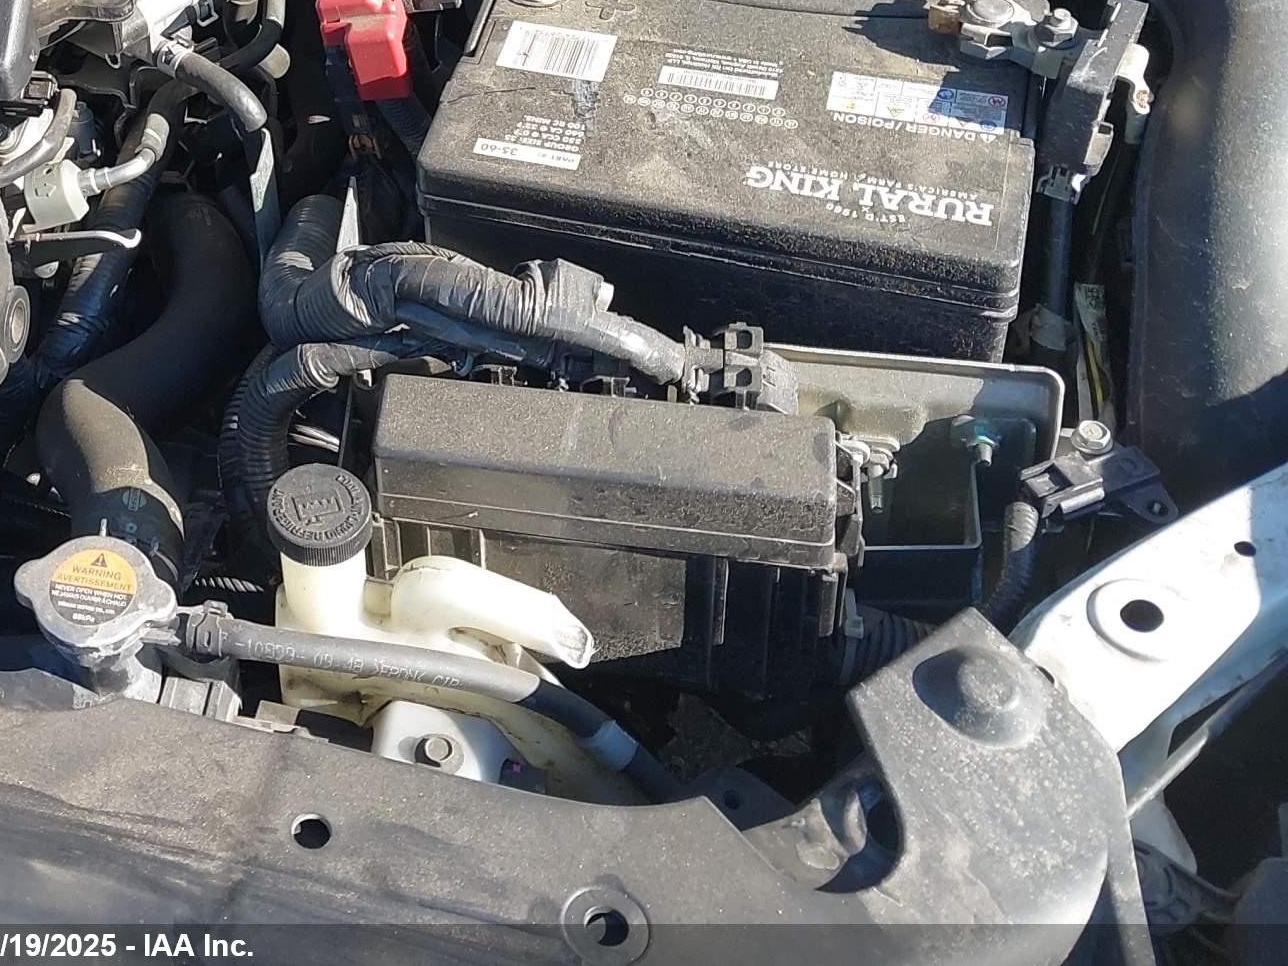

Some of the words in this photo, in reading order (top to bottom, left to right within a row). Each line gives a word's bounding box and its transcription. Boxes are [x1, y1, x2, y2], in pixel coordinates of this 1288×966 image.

[567, 121, 586, 130] 100
[833, 112, 895, 130] POISON
[905, 122, 976, 141] DANGER
[480, 143, 518, 156] 35-60
[543, 140, 579, 152] GROUP
[767, 160, 806, 173] STORE
[811, 167, 848, 180] HOME
[743, 164, 843, 201] KING
[867, 176, 902, 188] FARM
[825, 202, 859, 218] 1960
[850, 182, 995, 227] RURAL
[72, 565, 122, 580] WARNING
[57, 573, 132, 592] AVERTISSEMENT
[55, 584, 75, 592] NEVER
[76, 587, 93, 595] OPEN
[93, 590, 113, 598] WHEN
